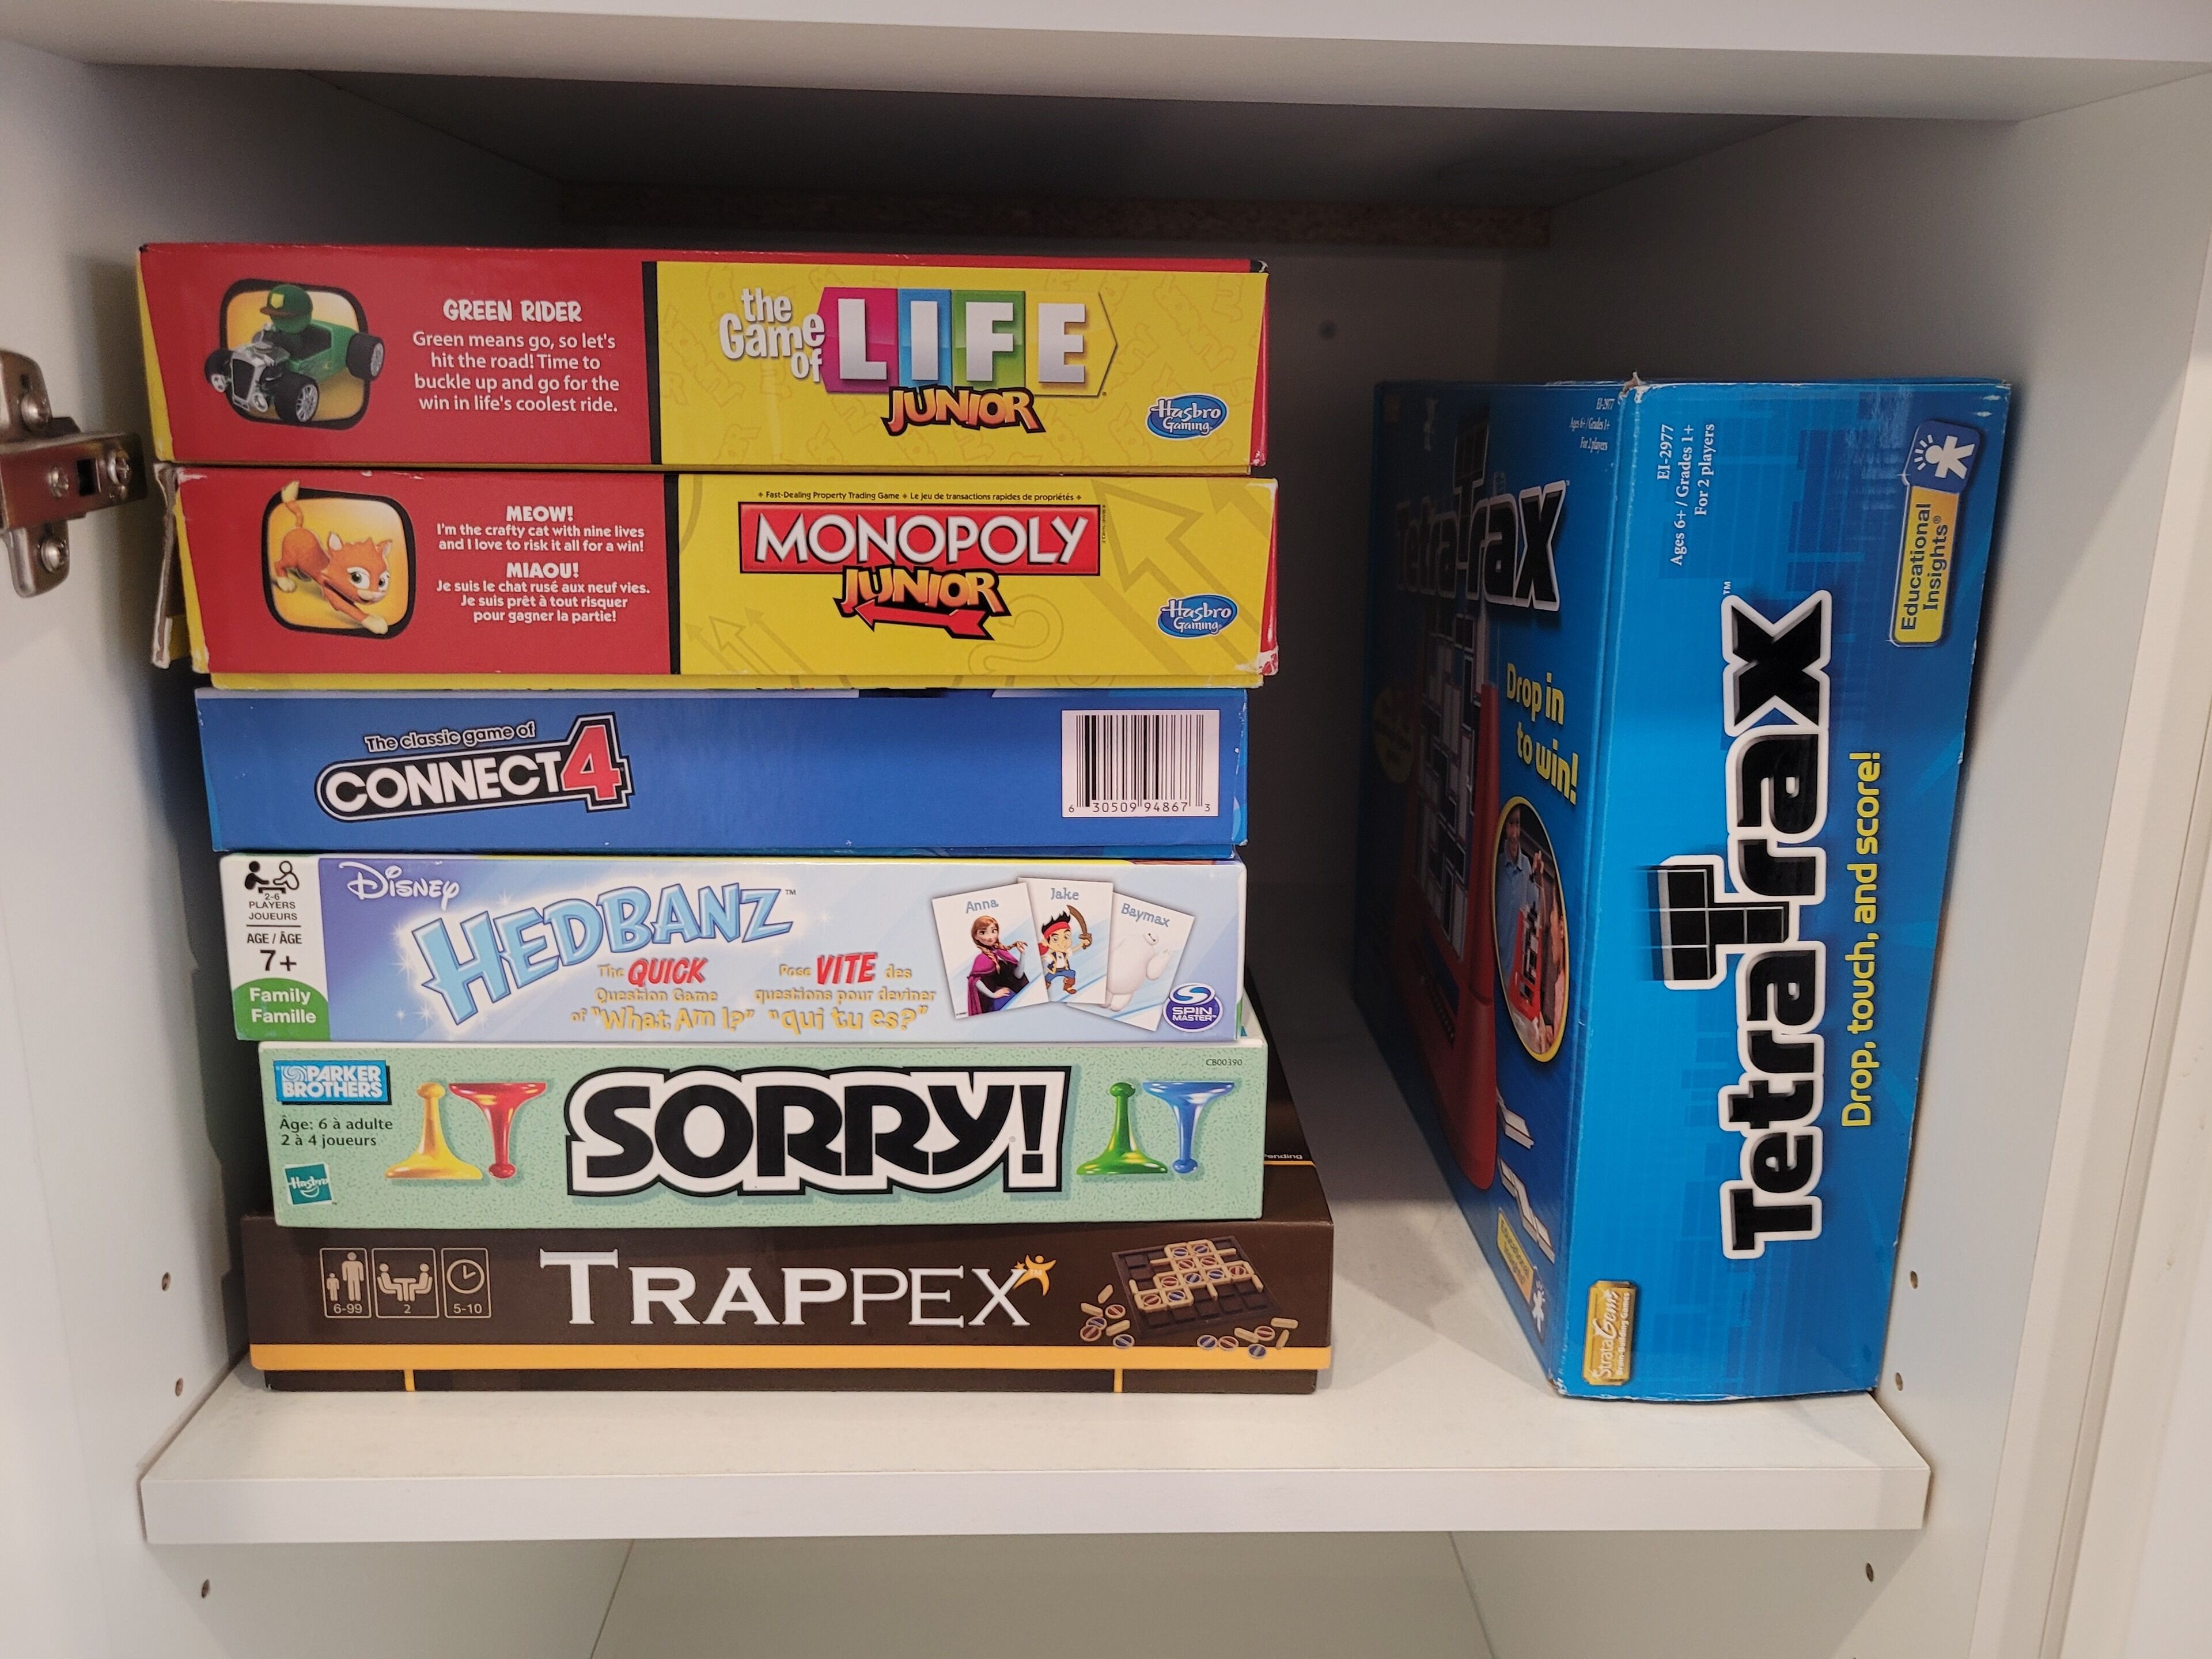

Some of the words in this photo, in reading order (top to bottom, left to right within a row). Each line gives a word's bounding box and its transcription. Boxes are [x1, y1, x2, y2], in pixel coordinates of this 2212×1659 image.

[443, 299, 513, 322] GREEN
[521, 301, 582, 323] RIDER
[742, 287, 791, 323] the
[413, 331, 463, 346] Green
[469, 336, 524, 347] means
[529, 336, 554, 350] go,
[559, 336, 577, 348] so
[582, 332, 616, 349] let's
[719, 312, 825, 361] Game
[837, 297, 1086, 384] LIFE
[431, 352, 454, 368] hit
[458, 353, 486, 368] the
[491, 354, 534, 369] road!
[537, 354, 578, 369] Time
[582, 356, 600, 369] to
[791, 348, 823, 383] of
[415, 373, 471, 389] buckle
[476, 377, 497, 392] up
[502, 375, 533, 390] and
[538, 378, 559, 394] go
[564, 375, 588, 391] for
[592, 376, 619, 391] the
[419, 396, 449, 410] win
[454, 396, 469, 410] in
[474, 396, 512, 411] life's
[516, 396, 576, 411] coolest
[581, 397, 618, 412] ride.
[886, 387, 1040, 433] JUNIOR
[1151, 399, 1221, 422] Hasbro
[1162, 416, 1210, 434] Gaming
[1681, 424, 1694, 442] 1+
[1657, 424, 1674, 480] EI-2977
[1698, 423, 1716, 476] players
[1676, 446, 1692, 498] Grades
[1698, 479, 1709, 487] 2
[766, 491, 811, 499] Fast-Dealing
[813, 492, 847, 500] Property
[849, 492, 876, 500] Trading
[921, 493, 932, 501] jeu
[993, 493, 1021, 501] rapides
[1034, 493, 1074, 501] propriétés
[1694, 490, 1709, 516] For
[506, 505, 574, 522] MEOW!
[1674, 510, 1686, 529] 6+
[437, 523, 456, 535] I'm
[460, 524, 482, 536] the
[485, 523, 525, 538] crafty
[528, 525, 550, 536] cat
[552, 525, 580, 537] with
[584, 525, 611, 537] nine
[615, 525, 645, 538] lives
[755, 513, 1089, 565] MONOPOLY
[1671, 532, 1687, 566] Ages
[506, 562, 579, 578] MIAOU!
[1901, 503, 1931, 630] Educational
[436, 579, 451, 592] Je
[454, 580, 479, 592] suis
[483, 580, 494, 592] le
[498, 581, 527, 592] chat
[531, 581, 558, 593] rusé
[562, 583, 585, 593] aux
[588, 582, 617, 593] neuf
[619, 582, 650, 594] vies.
[840, 566, 1008, 614] JUNIOR
[461, 594, 475, 607] Je
[479, 595, 504, 607] suis
[507, 594, 535, 609] prêt
[539, 595, 547, 607] à
[550, 597, 578, 608] tout
[581, 597, 628, 609] risquer
[1161, 600, 1232, 622] Hasbro
[473, 611, 505, 623] pour
[508, 611, 554, 624] gagner
[556, 610, 568, 622] la
[571, 611, 616, 624] partie!
[1173, 617, 1218, 634] Gaming
[1506, 662, 1542, 722] Drop
[1546, 672, 1565, 725] in
[364, 736, 398, 752] The
[400, 729, 461, 748] classic
[463, 726, 514, 747] game
[516, 720, 536, 737] of
[1517, 722, 1533, 765] to
[1536, 738, 1578, 805] win!
[1093, 802, 1137, 812] 30509
[1144, 802, 1188, 812] 94867
[1849, 752, 1882, 855] score!
[264, 892, 280, 900] 2-6
[1050, 887, 1079, 901] Jake
[1847, 863, 1879, 925] and
[249, 900, 296, 909] PLAYERS
[965, 897, 999, 914] Anna
[248, 911, 298, 921] JOUEURS
[1120, 903, 1170, 927] Baymax
[247, 933, 270, 944] AGE
[279, 930, 302, 945] ÂGE
[260, 949, 297, 972] 7+
[411, 883, 793, 1026] HEDBANZ
[598, 964, 624, 978] The
[627, 957, 708, 987] QUICK
[780, 964, 812, 977] Pose
[817, 952, 878, 985] VITE
[885, 964, 912, 979] des
[1844, 932, 1880, 1035] touch,
[249, 987, 310, 1005] Family
[594, 988, 668, 1004] Question
[672, 988, 717, 1001] Game
[754, 987, 832, 1004] questions
[836, 990, 872, 1005] pour
[877, 986, 936, 1001] deviner
[252, 1008, 317, 1024] Famille
[571, 1008, 588, 1021] of
[592, 1006, 671, 1031] "What
[675, 1008, 714, 1031] Am
[722, 1007, 754, 1032] I?"
[768, 1008, 824, 1036] "qui
[831, 1007, 862, 1029] tu
[870, 1005, 929, 1031] es?"
[307, 1065, 381, 1082] PARKER
[282, 1081, 382, 1098] BROTHERS
[1841, 1041, 1880, 1127] Drop,
[280, 1116, 313, 1132] Âge:
[319, 1119, 327, 1129] 6
[333, 1118, 340, 1130] à
[347, 1119, 393, 1130] adulte
[574, 1075, 1059, 1187] SORRY!
[281, 1135, 290, 1146] 2
[295, 1134, 303, 1146] à
[308, 1135, 317, 1146] 4
[322, 1135, 376, 1148] joueurs
[288, 1176, 329, 1189] Hasbro
[539, 1249, 1030, 1328] TRAPPEX
[333, 1304, 362, 1314] 6-99
[404, 1304, 411, 1314] 2
[453, 1304, 482, 1314] 5-10
